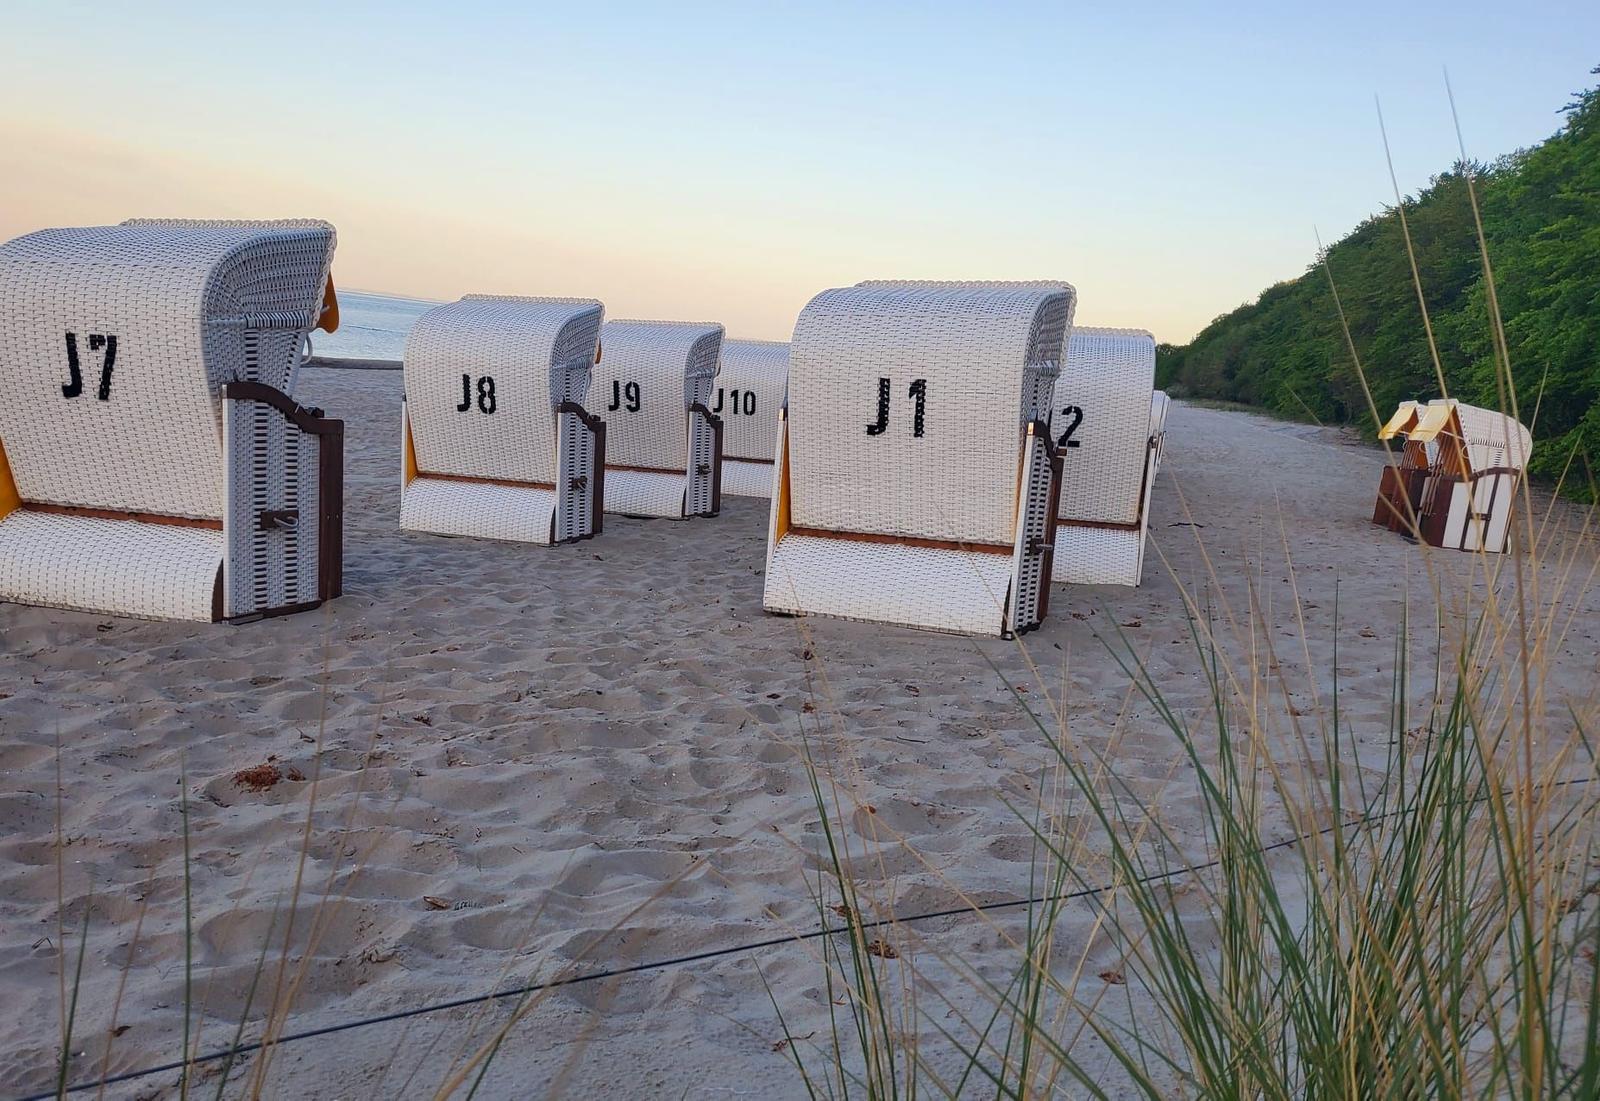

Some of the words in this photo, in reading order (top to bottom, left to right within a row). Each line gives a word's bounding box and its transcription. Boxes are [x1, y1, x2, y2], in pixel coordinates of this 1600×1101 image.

[62, 331, 117, 401] J7
[457, 374, 496, 415] J8
[608, 380, 641, 412] J9
[713, 388, 756, 416] J10
[866, 377, 927, 438] J1
[1048, 405, 1083, 448] 2
